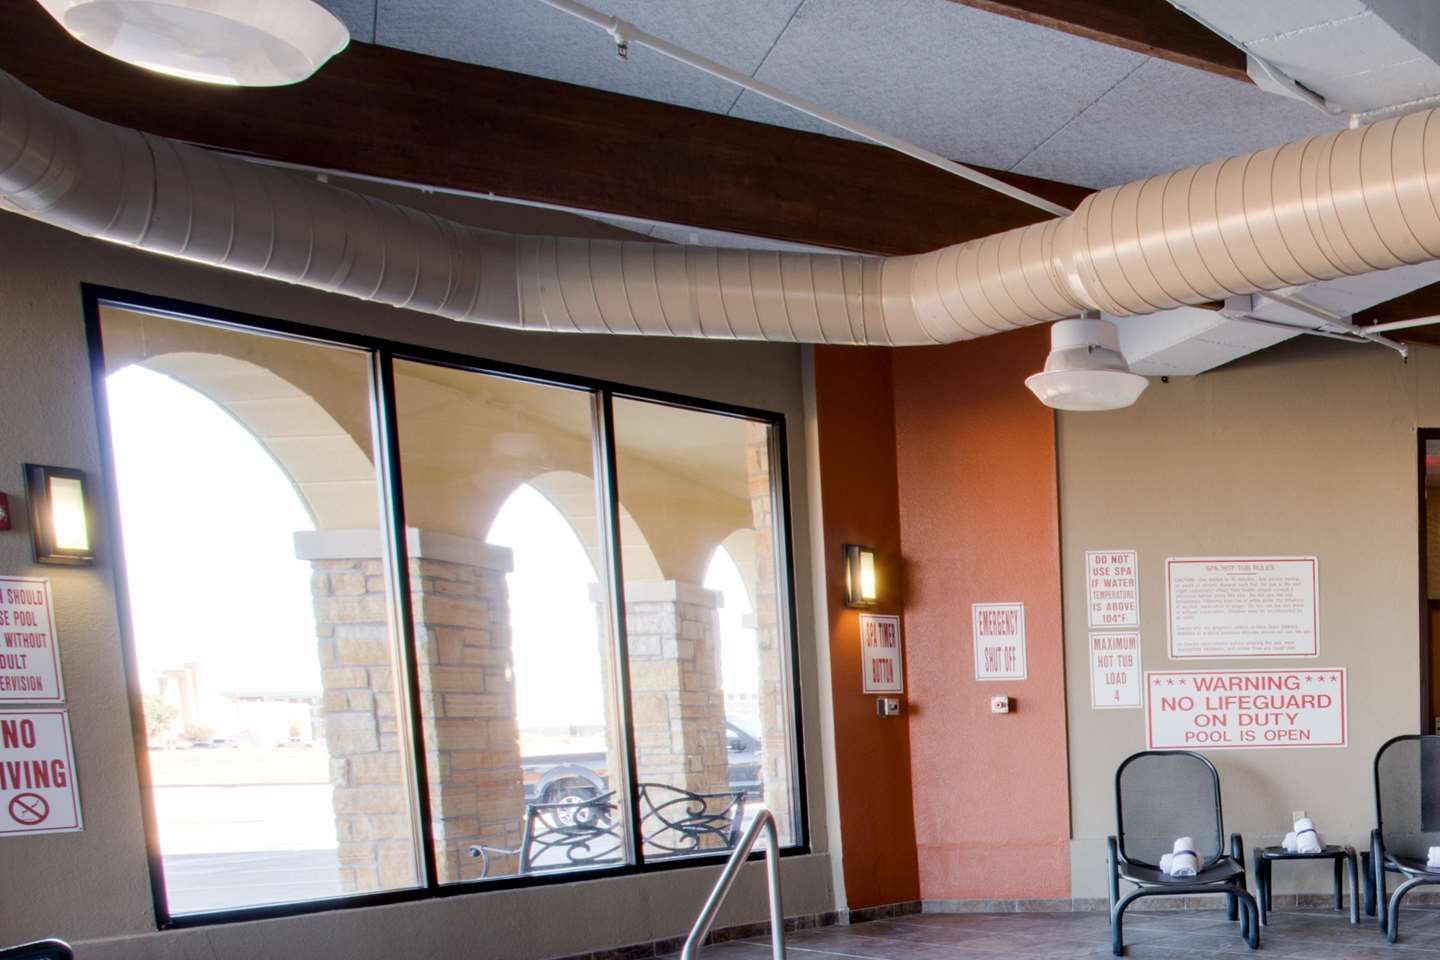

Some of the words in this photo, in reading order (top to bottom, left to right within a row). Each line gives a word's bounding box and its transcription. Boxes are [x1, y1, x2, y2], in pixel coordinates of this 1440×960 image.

[1095, 555, 1107, 564] DO
[1111, 554, 1128, 564] NOT
[1093, 567, 1110, 576] USE
[1114, 567, 1131, 576] SPA
[1091, 579, 1099, 588] IF
[1103, 579, 1134, 588] WATER
[7, 588, 43, 606] SHOULD
[1093, 602, 1102, 612] IS
[1106, 602, 1135, 611] ABOVE
[14, 611, 38, 626] POOL
[978, 610, 1018, 636] EMERGENCY
[4, 632, 47, 648] WITHOUT
[1093, 637, 1136, 650] MAXIMUM
[985, 646, 1001, 672] SHUT
[1004, 646, 1016, 672] OFF
[1097, 654, 1113, 668] HOT
[1117, 654, 1133, 668] TUB
[1105, 671, 1127, 685] LOAD
[1193, 675, 1301, 692] WARNING
[1114, 689, 1120, 702] 4
[1161, 696, 1194, 711] NO
[1206, 694, 1332, 711] LIFEGUARD
[1194, 713, 1227, 727] ON
[1238, 712, 1299, 727] DUTY
[1, 719, 36, 748] NO
[1185, 730, 1232, 743] POOL
[1240, 730, 1256, 742] IS
[1264, 729, 1311, 742] OPEN
